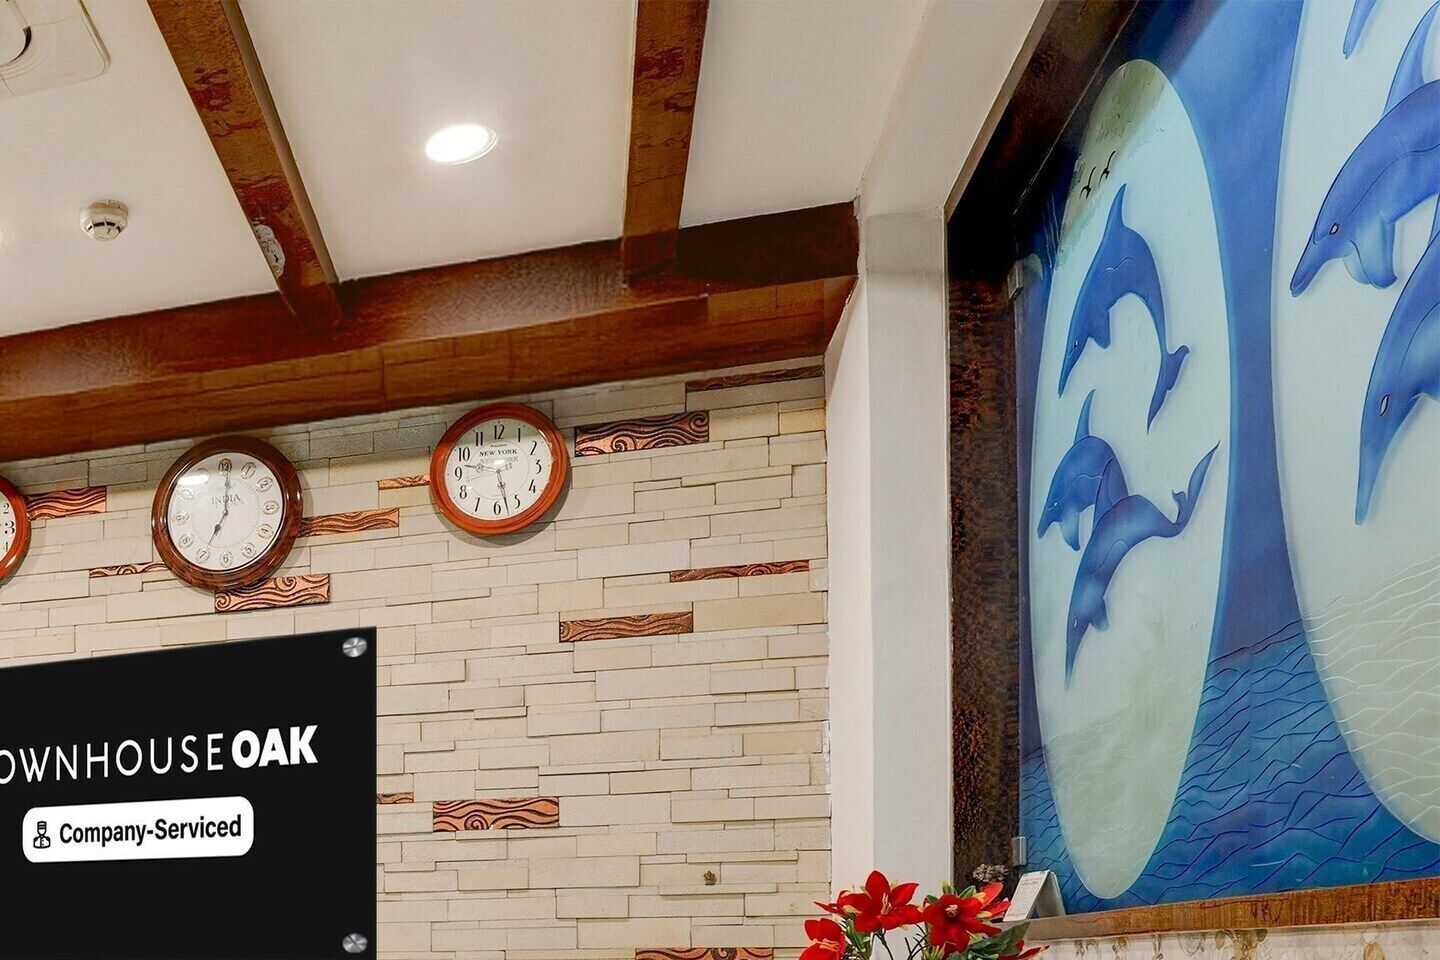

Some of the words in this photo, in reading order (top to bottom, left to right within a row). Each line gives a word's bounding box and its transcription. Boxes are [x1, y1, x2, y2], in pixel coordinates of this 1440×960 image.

[475, 431, 483, 446] 11
[493, 425, 505, 440] 12
[517, 428, 521, 442] 1
[458, 447, 471, 462] 10
[530, 441, 537, 456] 2
[454, 467, 463, 481] 9
[536, 460, 542, 474] 3
[459, 485, 467, 499] 8
[528, 479, 536, 493] 4
[211, 494, 241, 505] INDIA
[475, 498, 480, 512] 7
[514, 494, 521, 509] 5
[3, 503, 10, 514] 2
[493, 501, 501, 515] 6
[4, 521, 15, 534] 3
[59, 814, 242, 847] Company-Serviced
